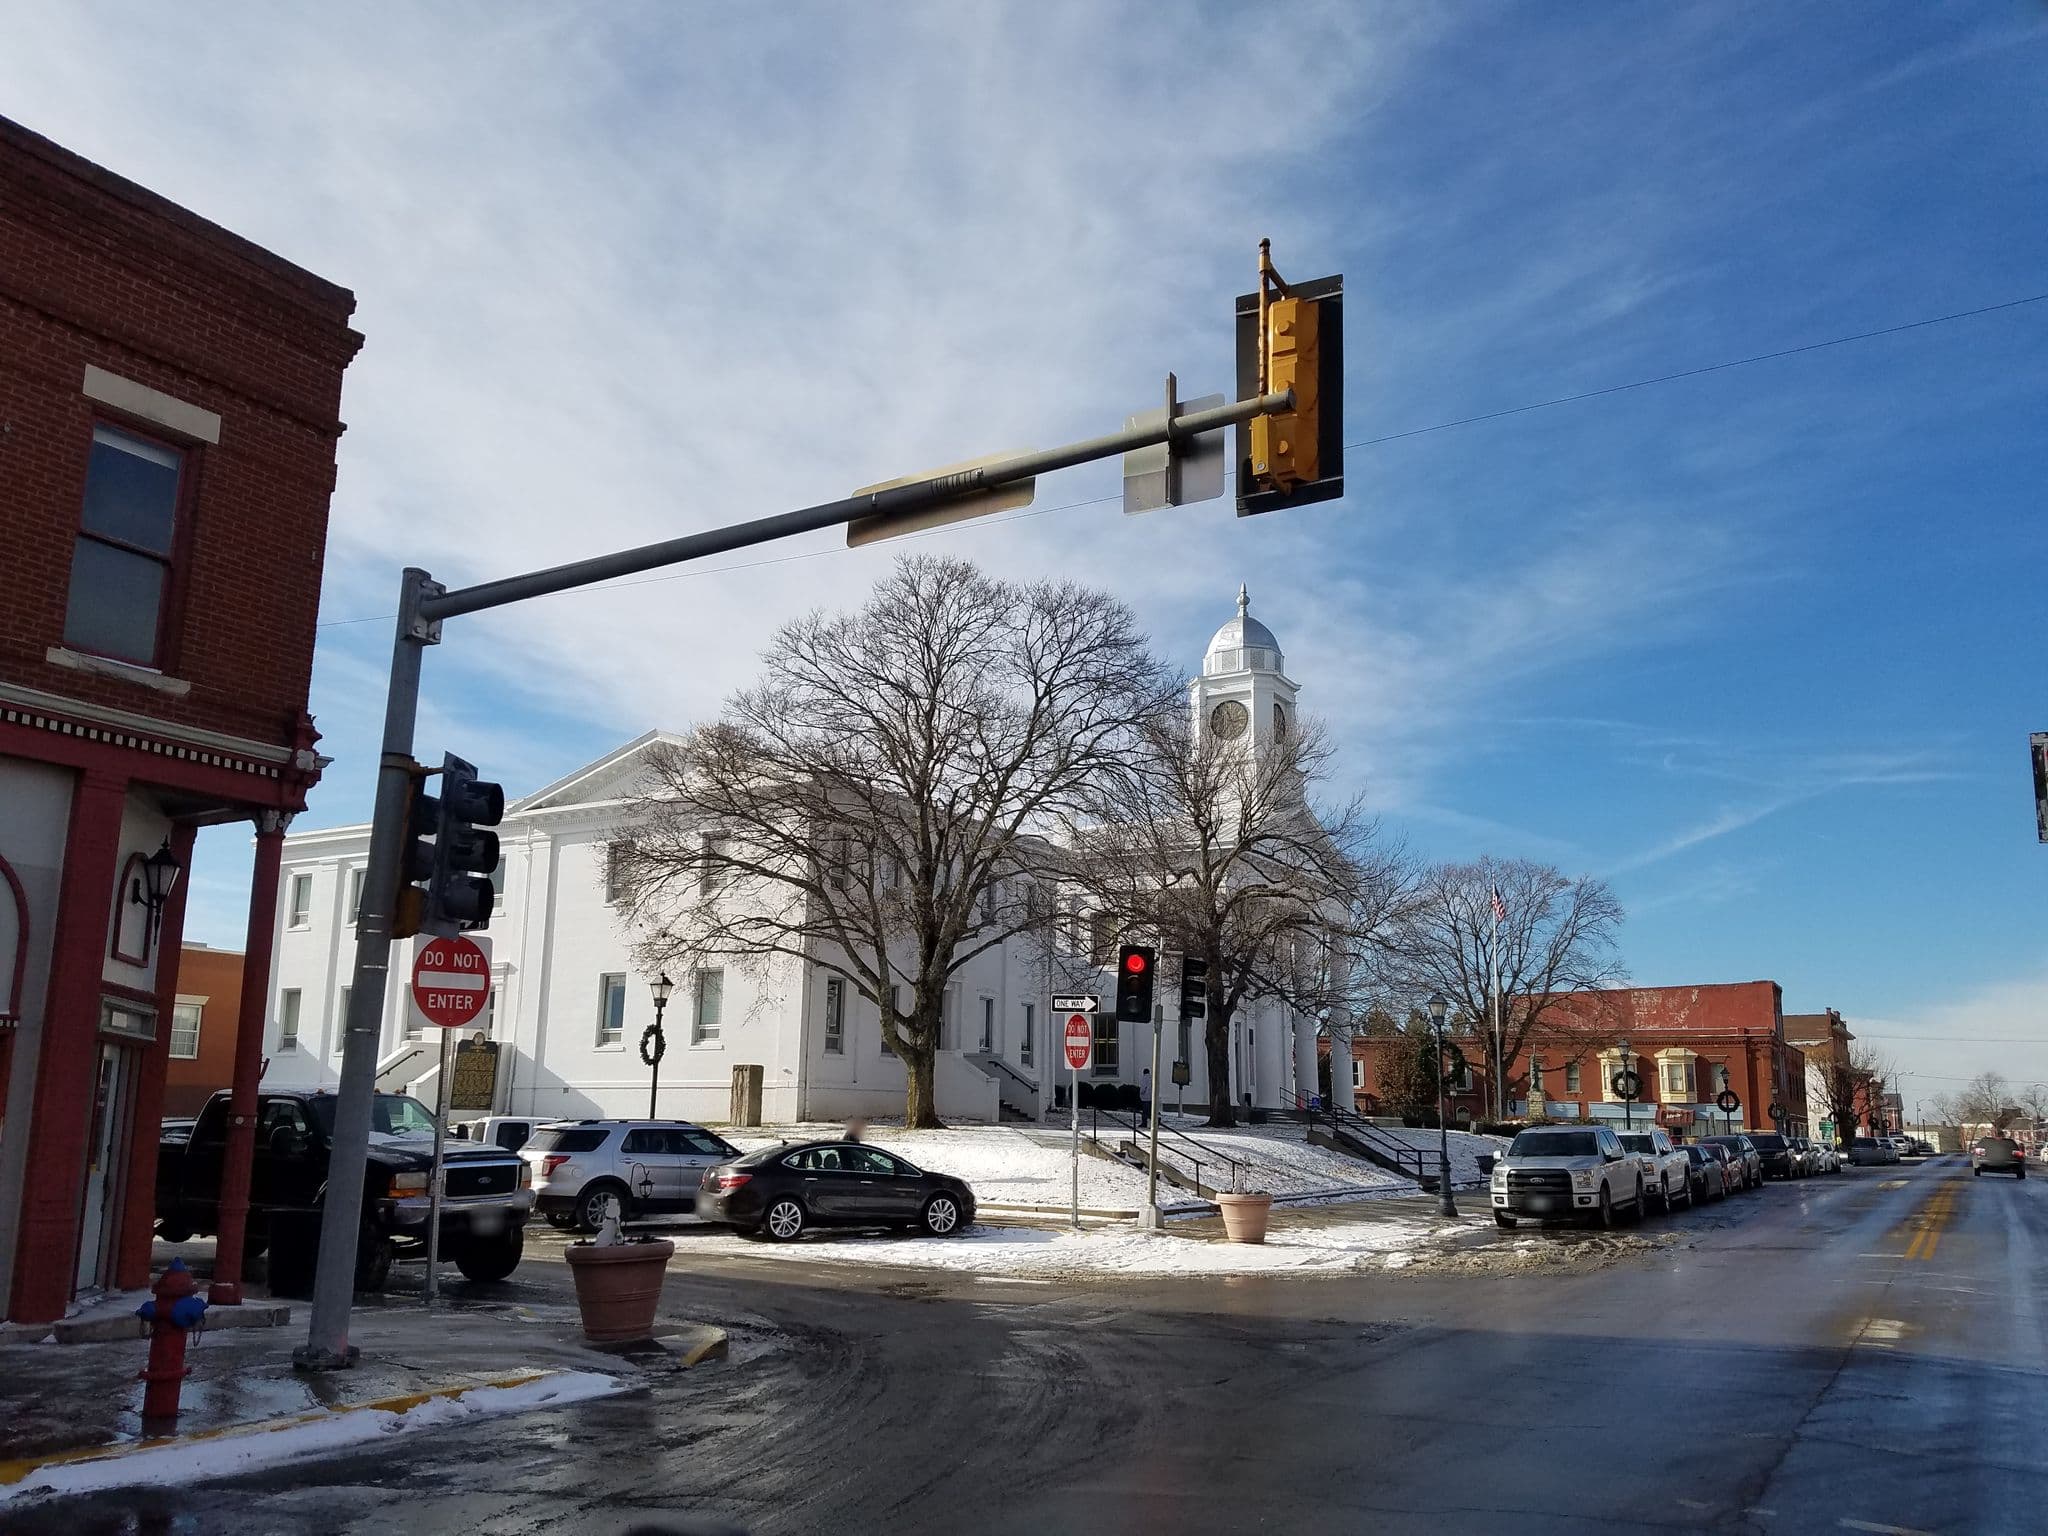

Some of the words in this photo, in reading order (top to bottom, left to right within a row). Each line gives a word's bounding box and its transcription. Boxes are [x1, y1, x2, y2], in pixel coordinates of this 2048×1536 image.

[425, 951, 444, 966] DO
[453, 952, 481, 969] NOT
[428, 993, 474, 1010] ENTER
[1067, 1025, 1075, 1033] DO
[1076, 1025, 1087, 1034] NOT
[1069, 1049, 1086, 1058] ENTER
